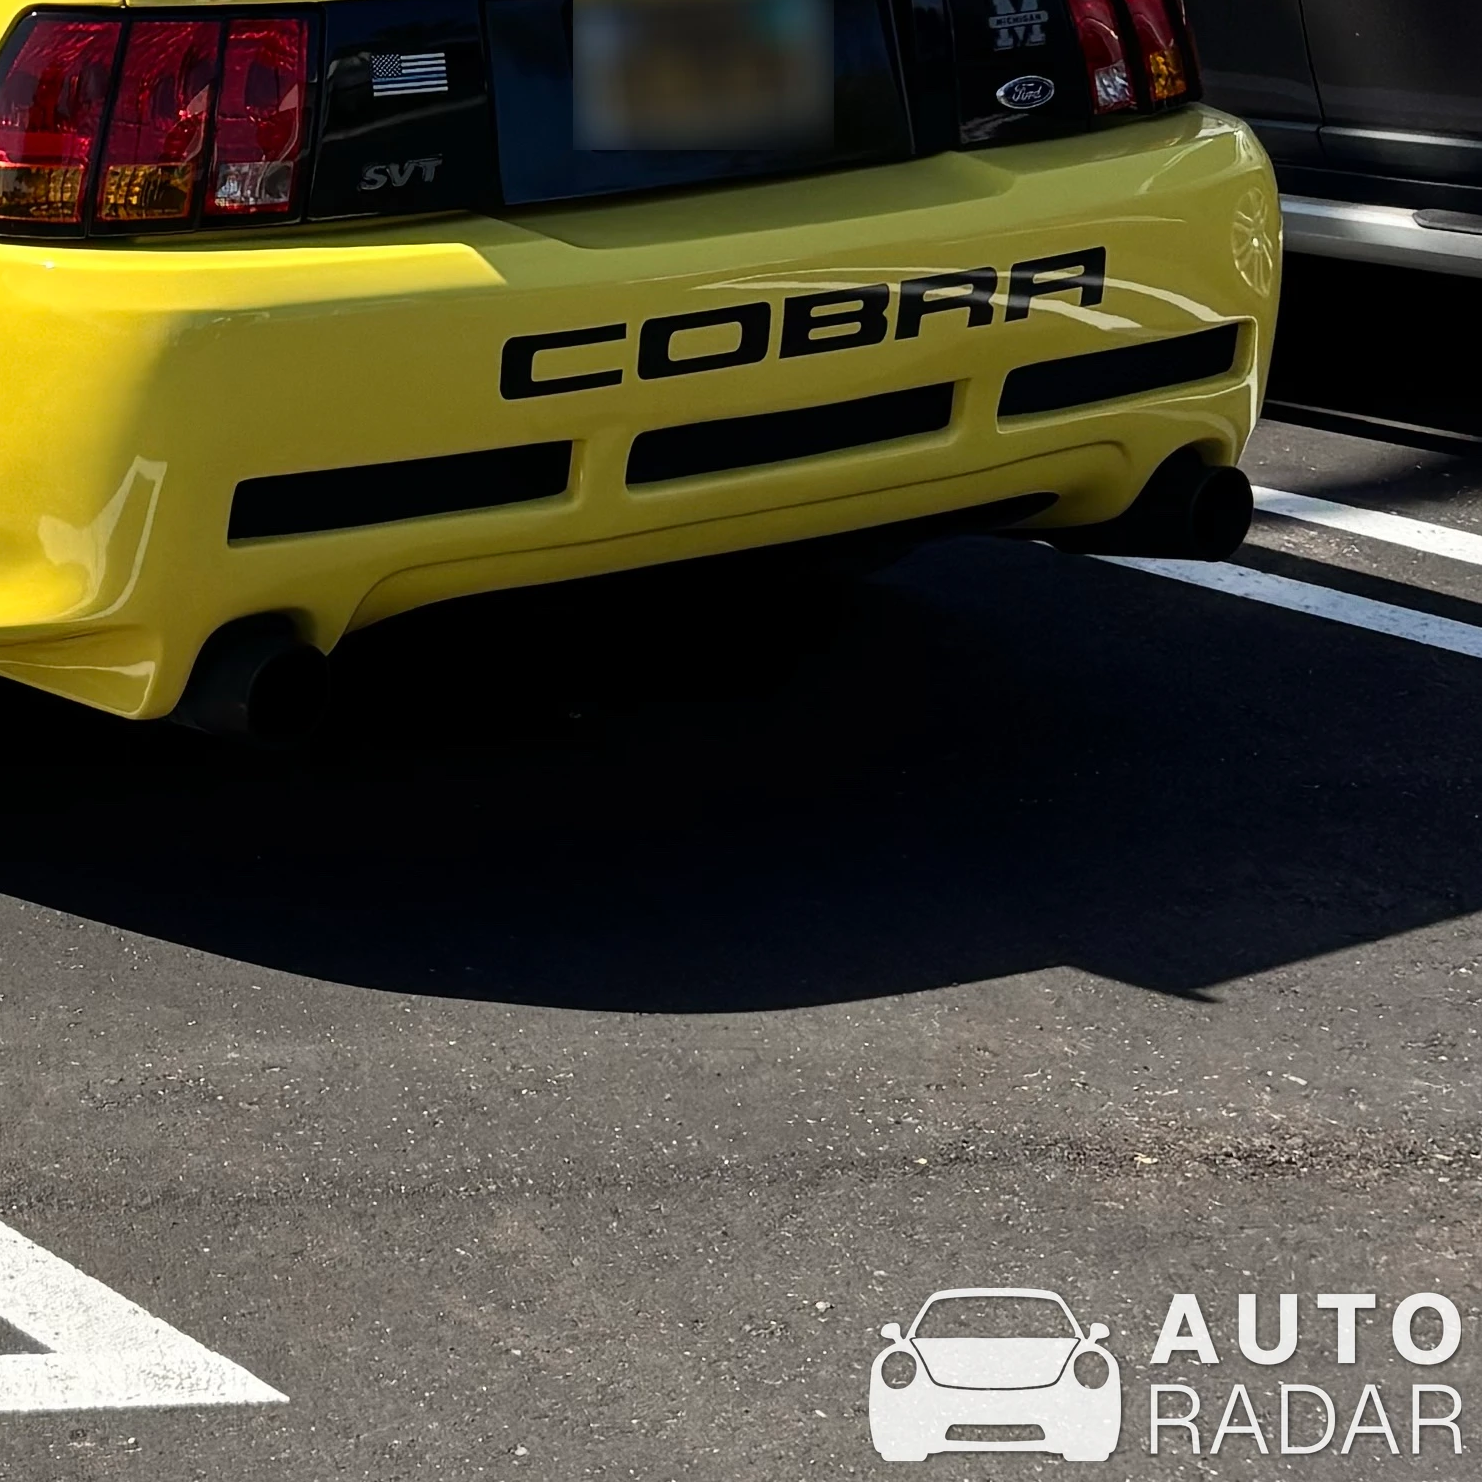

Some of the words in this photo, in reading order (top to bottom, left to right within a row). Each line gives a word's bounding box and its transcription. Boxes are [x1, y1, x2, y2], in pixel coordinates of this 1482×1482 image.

[995, 13, 1043, 26] MICHIGAN
[1012, 83, 1043, 102] Ford
[357, 155, 444, 192] SVT
[499, 246, 1107, 401] COBRA
